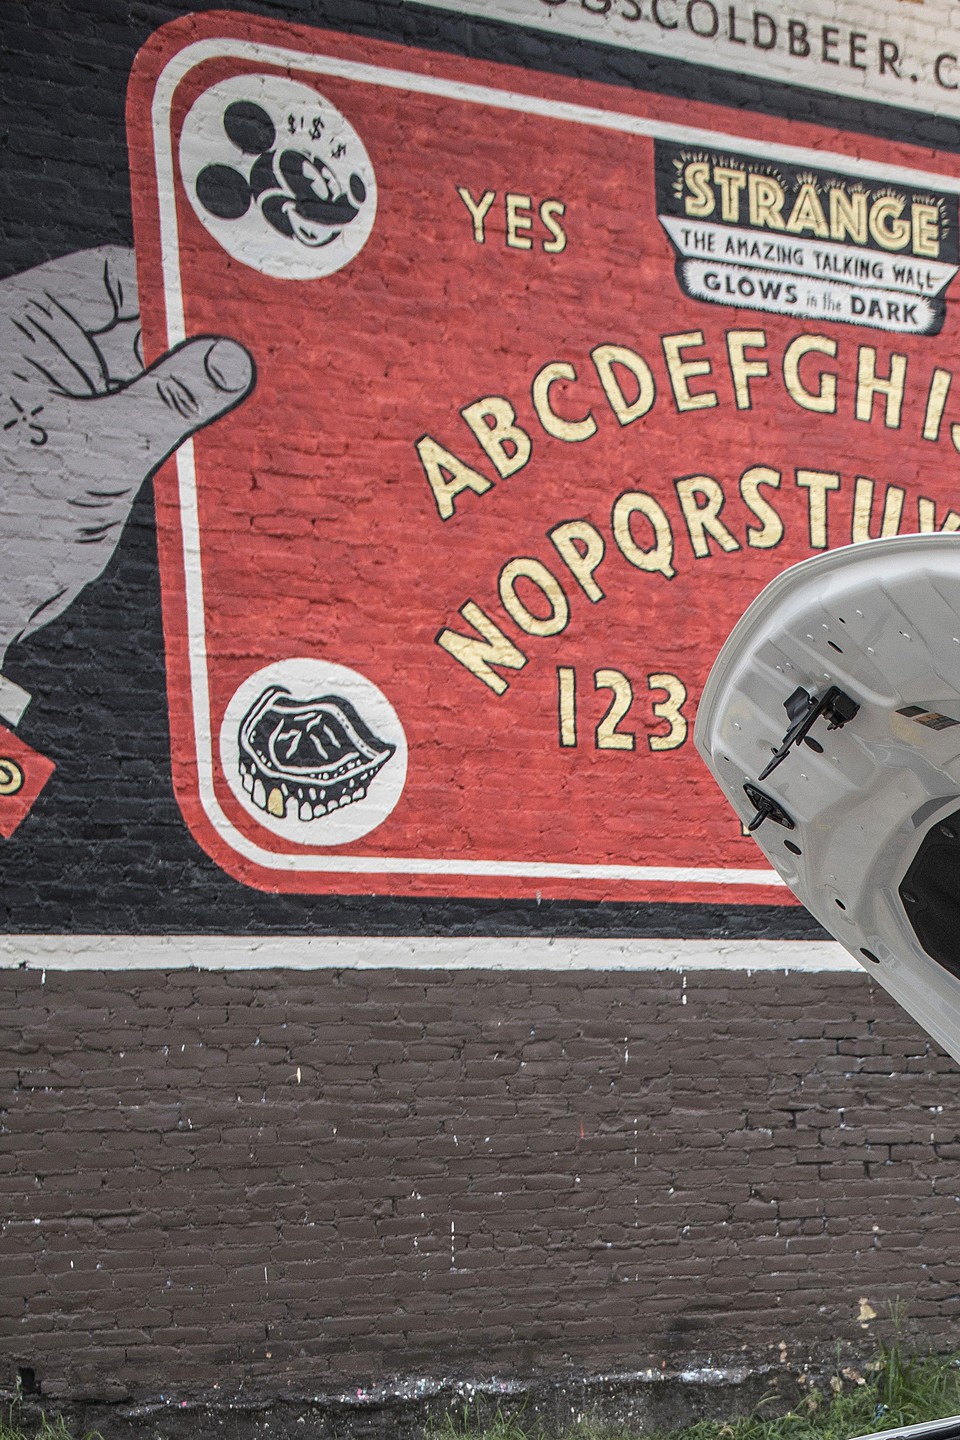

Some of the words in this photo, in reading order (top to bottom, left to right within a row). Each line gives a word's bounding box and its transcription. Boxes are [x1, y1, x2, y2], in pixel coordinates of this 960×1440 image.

[457, 186, 568, 254] YES
[683, 160, 942, 258] STRANGE
[680, 228, 716, 252] THE
[725, 234, 804, 266] AMAZING
[812, 249, 885, 280] TALKING
[892, 263, 936, 290] WALL
[703, 273, 798, 305] GLOWS
[805, 290, 818, 308] in
[822, 290, 842, 312] the
[850, 293, 921, 325] DARK
[556, 665, 690, 752] 123
